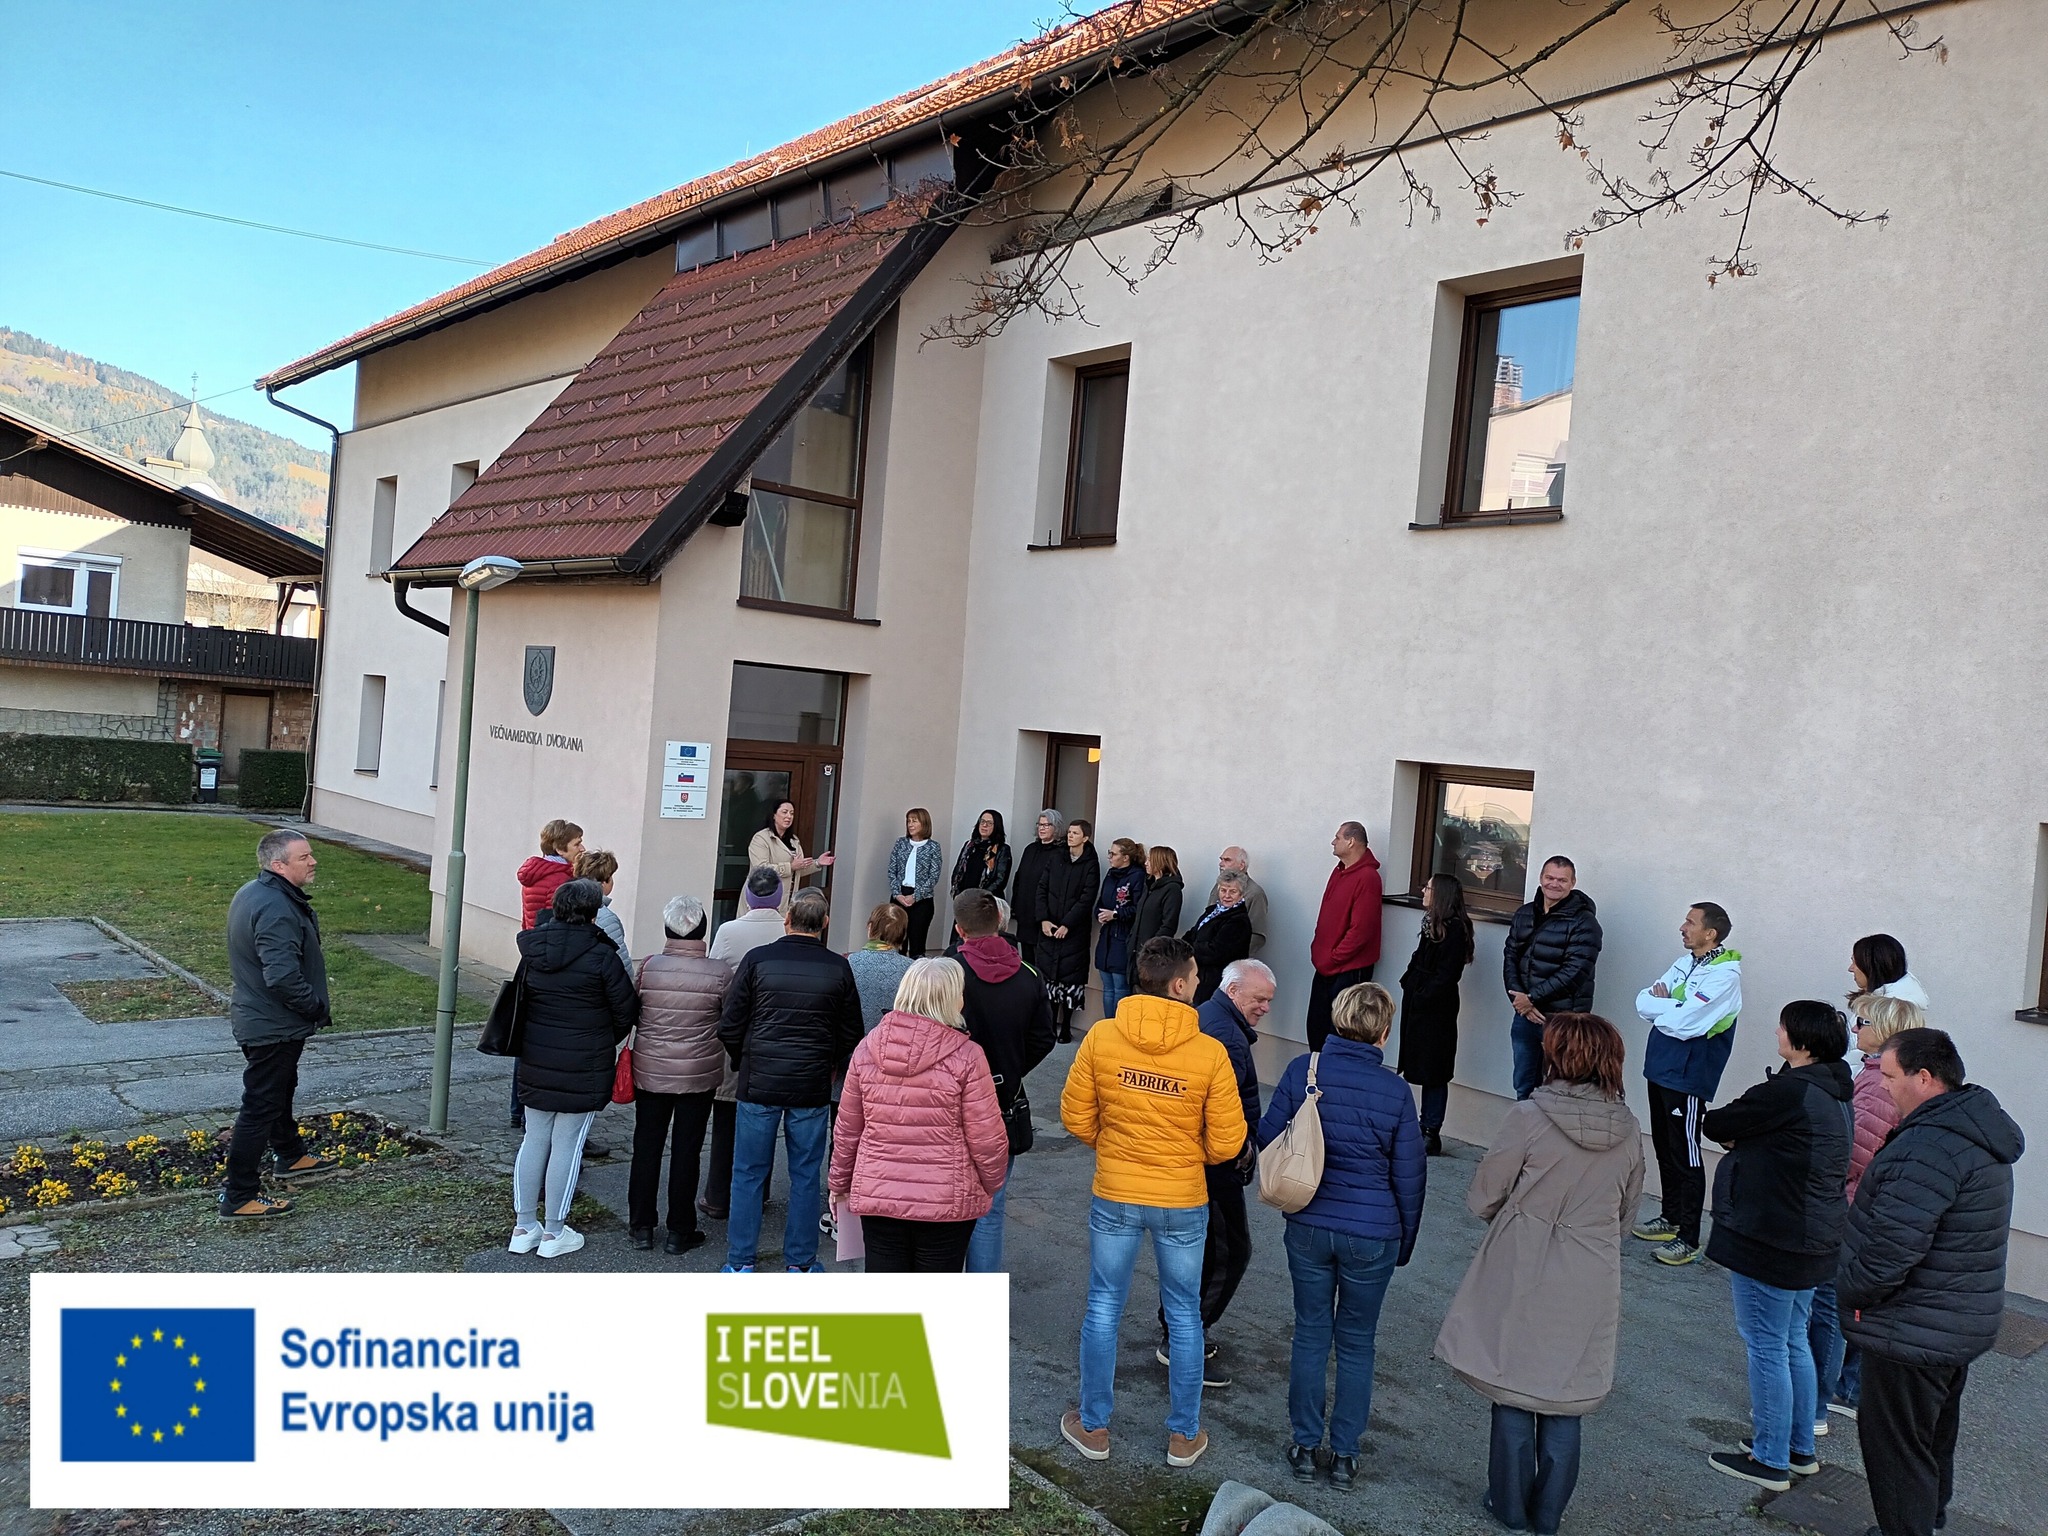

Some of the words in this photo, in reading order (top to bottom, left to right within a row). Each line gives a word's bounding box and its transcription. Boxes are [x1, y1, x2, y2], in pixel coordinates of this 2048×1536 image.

[489, 724, 543, 746] VEČNAMENSKA
[546, 733, 584, 753] DVORANA
[1123, 1070, 1180, 1094] FABRIKA
